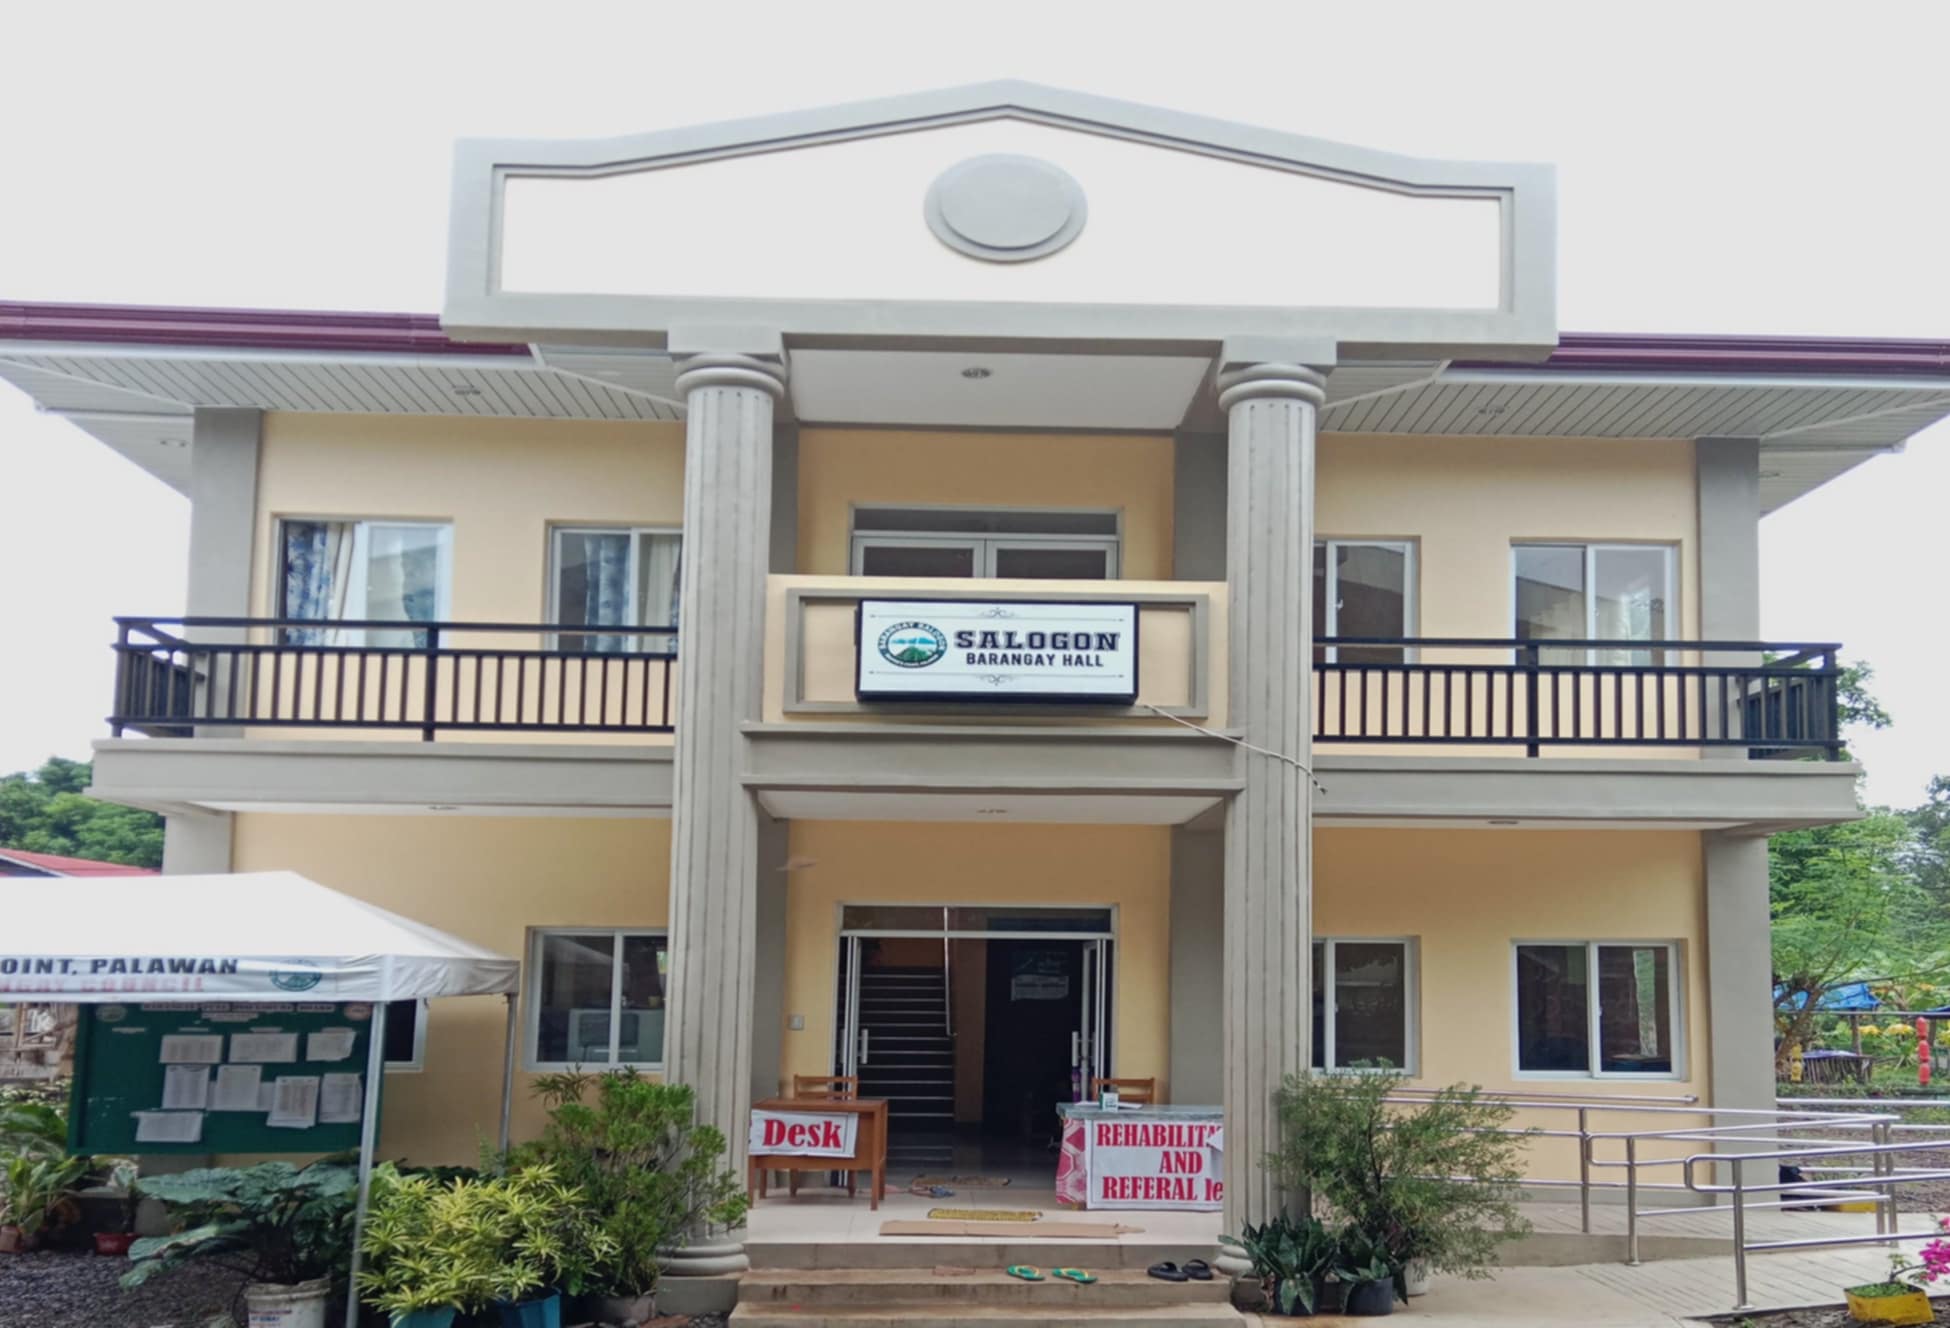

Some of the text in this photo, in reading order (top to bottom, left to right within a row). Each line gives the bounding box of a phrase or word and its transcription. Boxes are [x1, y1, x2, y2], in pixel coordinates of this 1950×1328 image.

[954, 630, 1120, 651] SALOGON
[966, 652, 1104, 667] BARANGAY HALL
[89, 958, 239, 975] PALAWAN
[762, 1118, 842, 1149] Desk
[1159, 1151, 1203, 1174] AND
[1102, 1176, 1198, 1200] REFERAL
